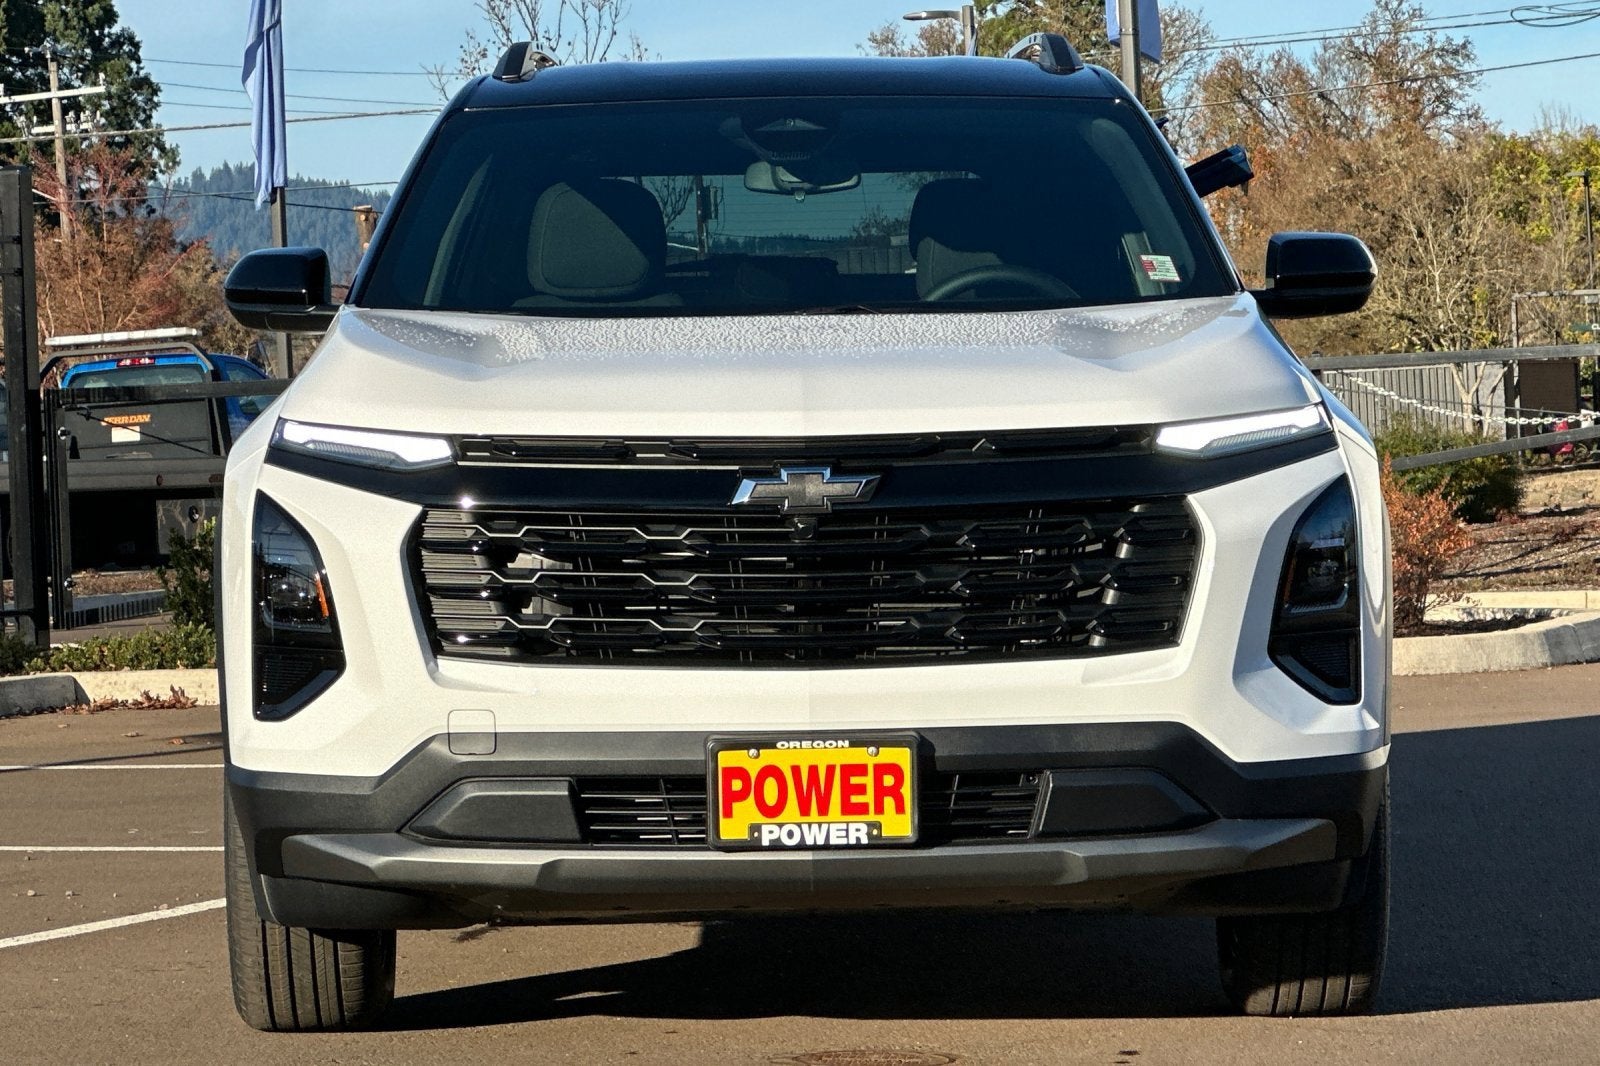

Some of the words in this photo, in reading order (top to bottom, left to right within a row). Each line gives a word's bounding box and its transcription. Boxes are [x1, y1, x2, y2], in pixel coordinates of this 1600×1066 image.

[776, 740, 850, 749] OREGON
[721, 763, 906, 819] POWER
[761, 823, 869, 846] POWER
